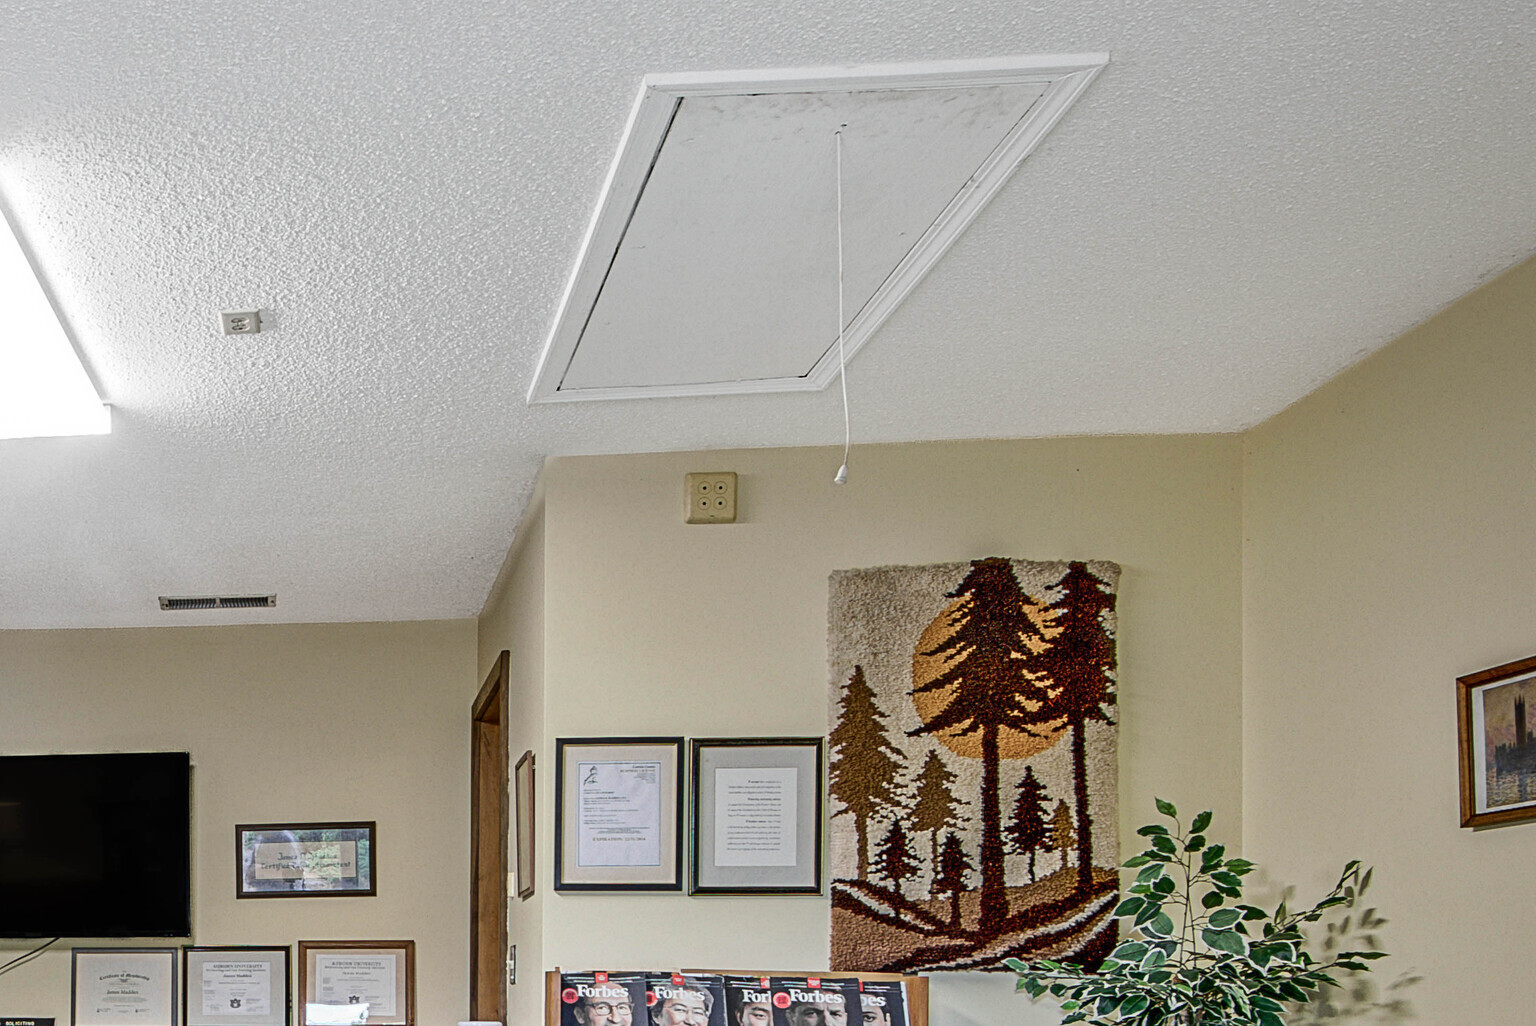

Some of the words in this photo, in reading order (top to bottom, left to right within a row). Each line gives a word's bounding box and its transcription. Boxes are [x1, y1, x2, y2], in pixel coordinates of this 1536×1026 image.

[575, 984, 629, 998] Forbes
[653, 986, 706, 1001] Forbes
[789, 988, 843, 1004] Forbes
